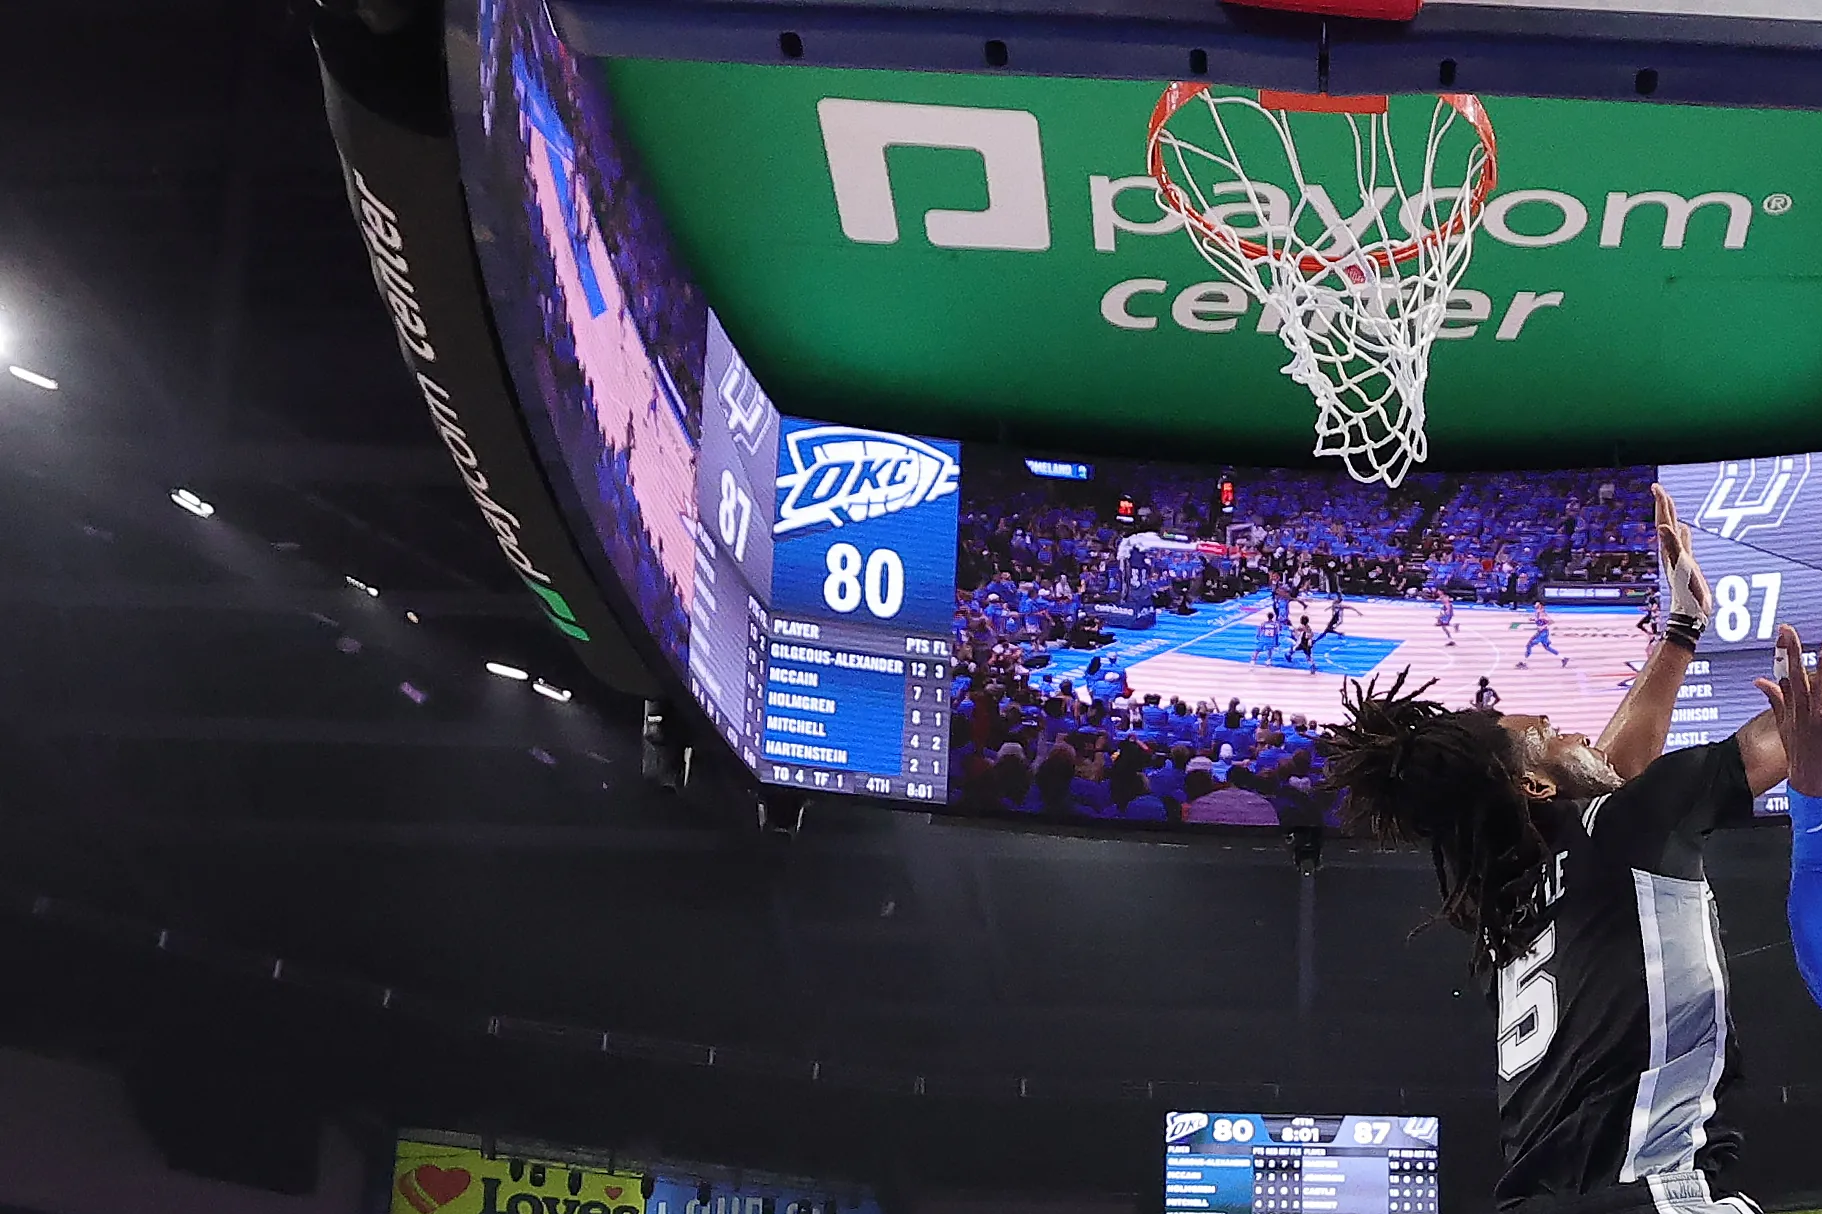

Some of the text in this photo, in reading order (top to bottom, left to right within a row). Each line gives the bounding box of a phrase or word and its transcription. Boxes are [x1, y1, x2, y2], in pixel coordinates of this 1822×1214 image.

[352, 167, 552, 584] paycom center
[718, 469, 751, 563] 87
[823, 542, 905, 618] 80
[1714, 571, 1782, 642] 87
[774, 618, 949, 656] PLAYER PTS FL
[770, 643, 944, 678] GILGEOUS-ALEXANDER 12 3
[769, 667, 819, 688] MCCAIN
[913, 686, 922, 700] 7
[936, 688, 943, 703] 1
[1677, 684, 1713, 698] ARPER
[768, 691, 942, 727] HOLMGREN 8 1
[1671, 707, 1719, 723] OHNSON
[766, 714, 941, 750] MITCHELL 4 2
[1666, 731, 1710, 747] CASTLE
[765, 739, 939, 775] HARTENSTEIN 2 1
[773, 765, 844, 788] TO 4 TF 1
[866, 777, 933, 799] 4TH 8:01
[1765, 796, 1789, 811] 4TH
[1496, 919, 1559, 1082] 5
[1212, 1118, 1255, 1142] 80
[1281, 1126, 1320, 1142] 8:01
[1353, 1121, 1391, 1144] 87
[1281, 1159, 1288, 1168] 7
